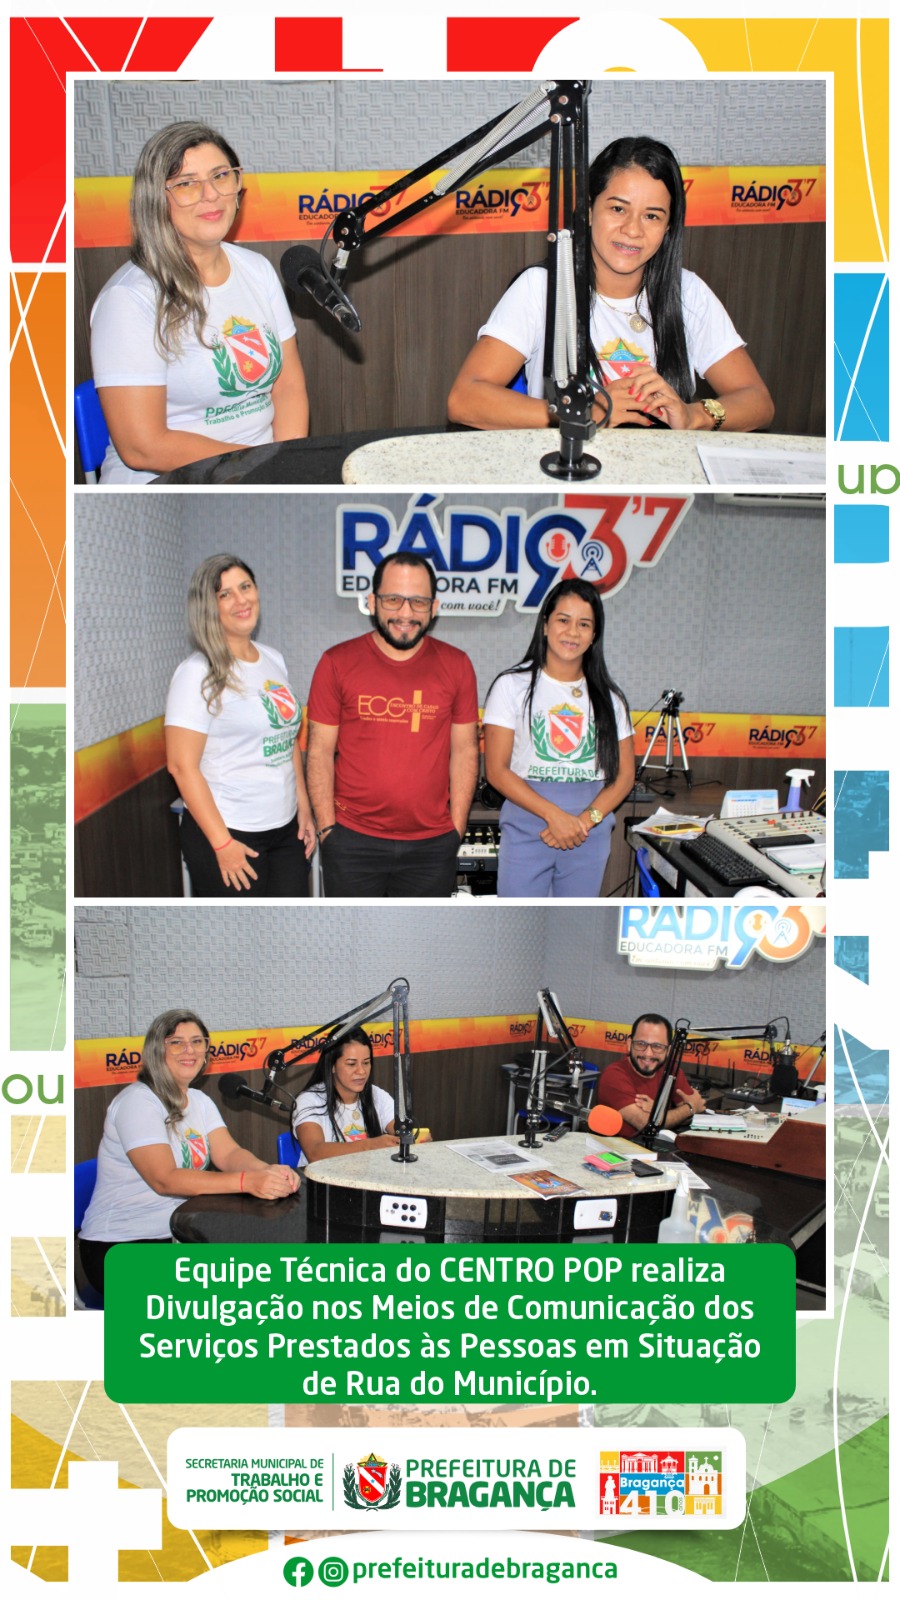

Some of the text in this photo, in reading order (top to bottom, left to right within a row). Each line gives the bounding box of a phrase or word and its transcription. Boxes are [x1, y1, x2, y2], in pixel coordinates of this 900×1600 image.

[487, 578, 519, 595] FM
[467, 600, 500, 612] você!
[528, 765, 587, 777] PREFEITURA
[620, 941, 728, 956] EDUCADORA FM
